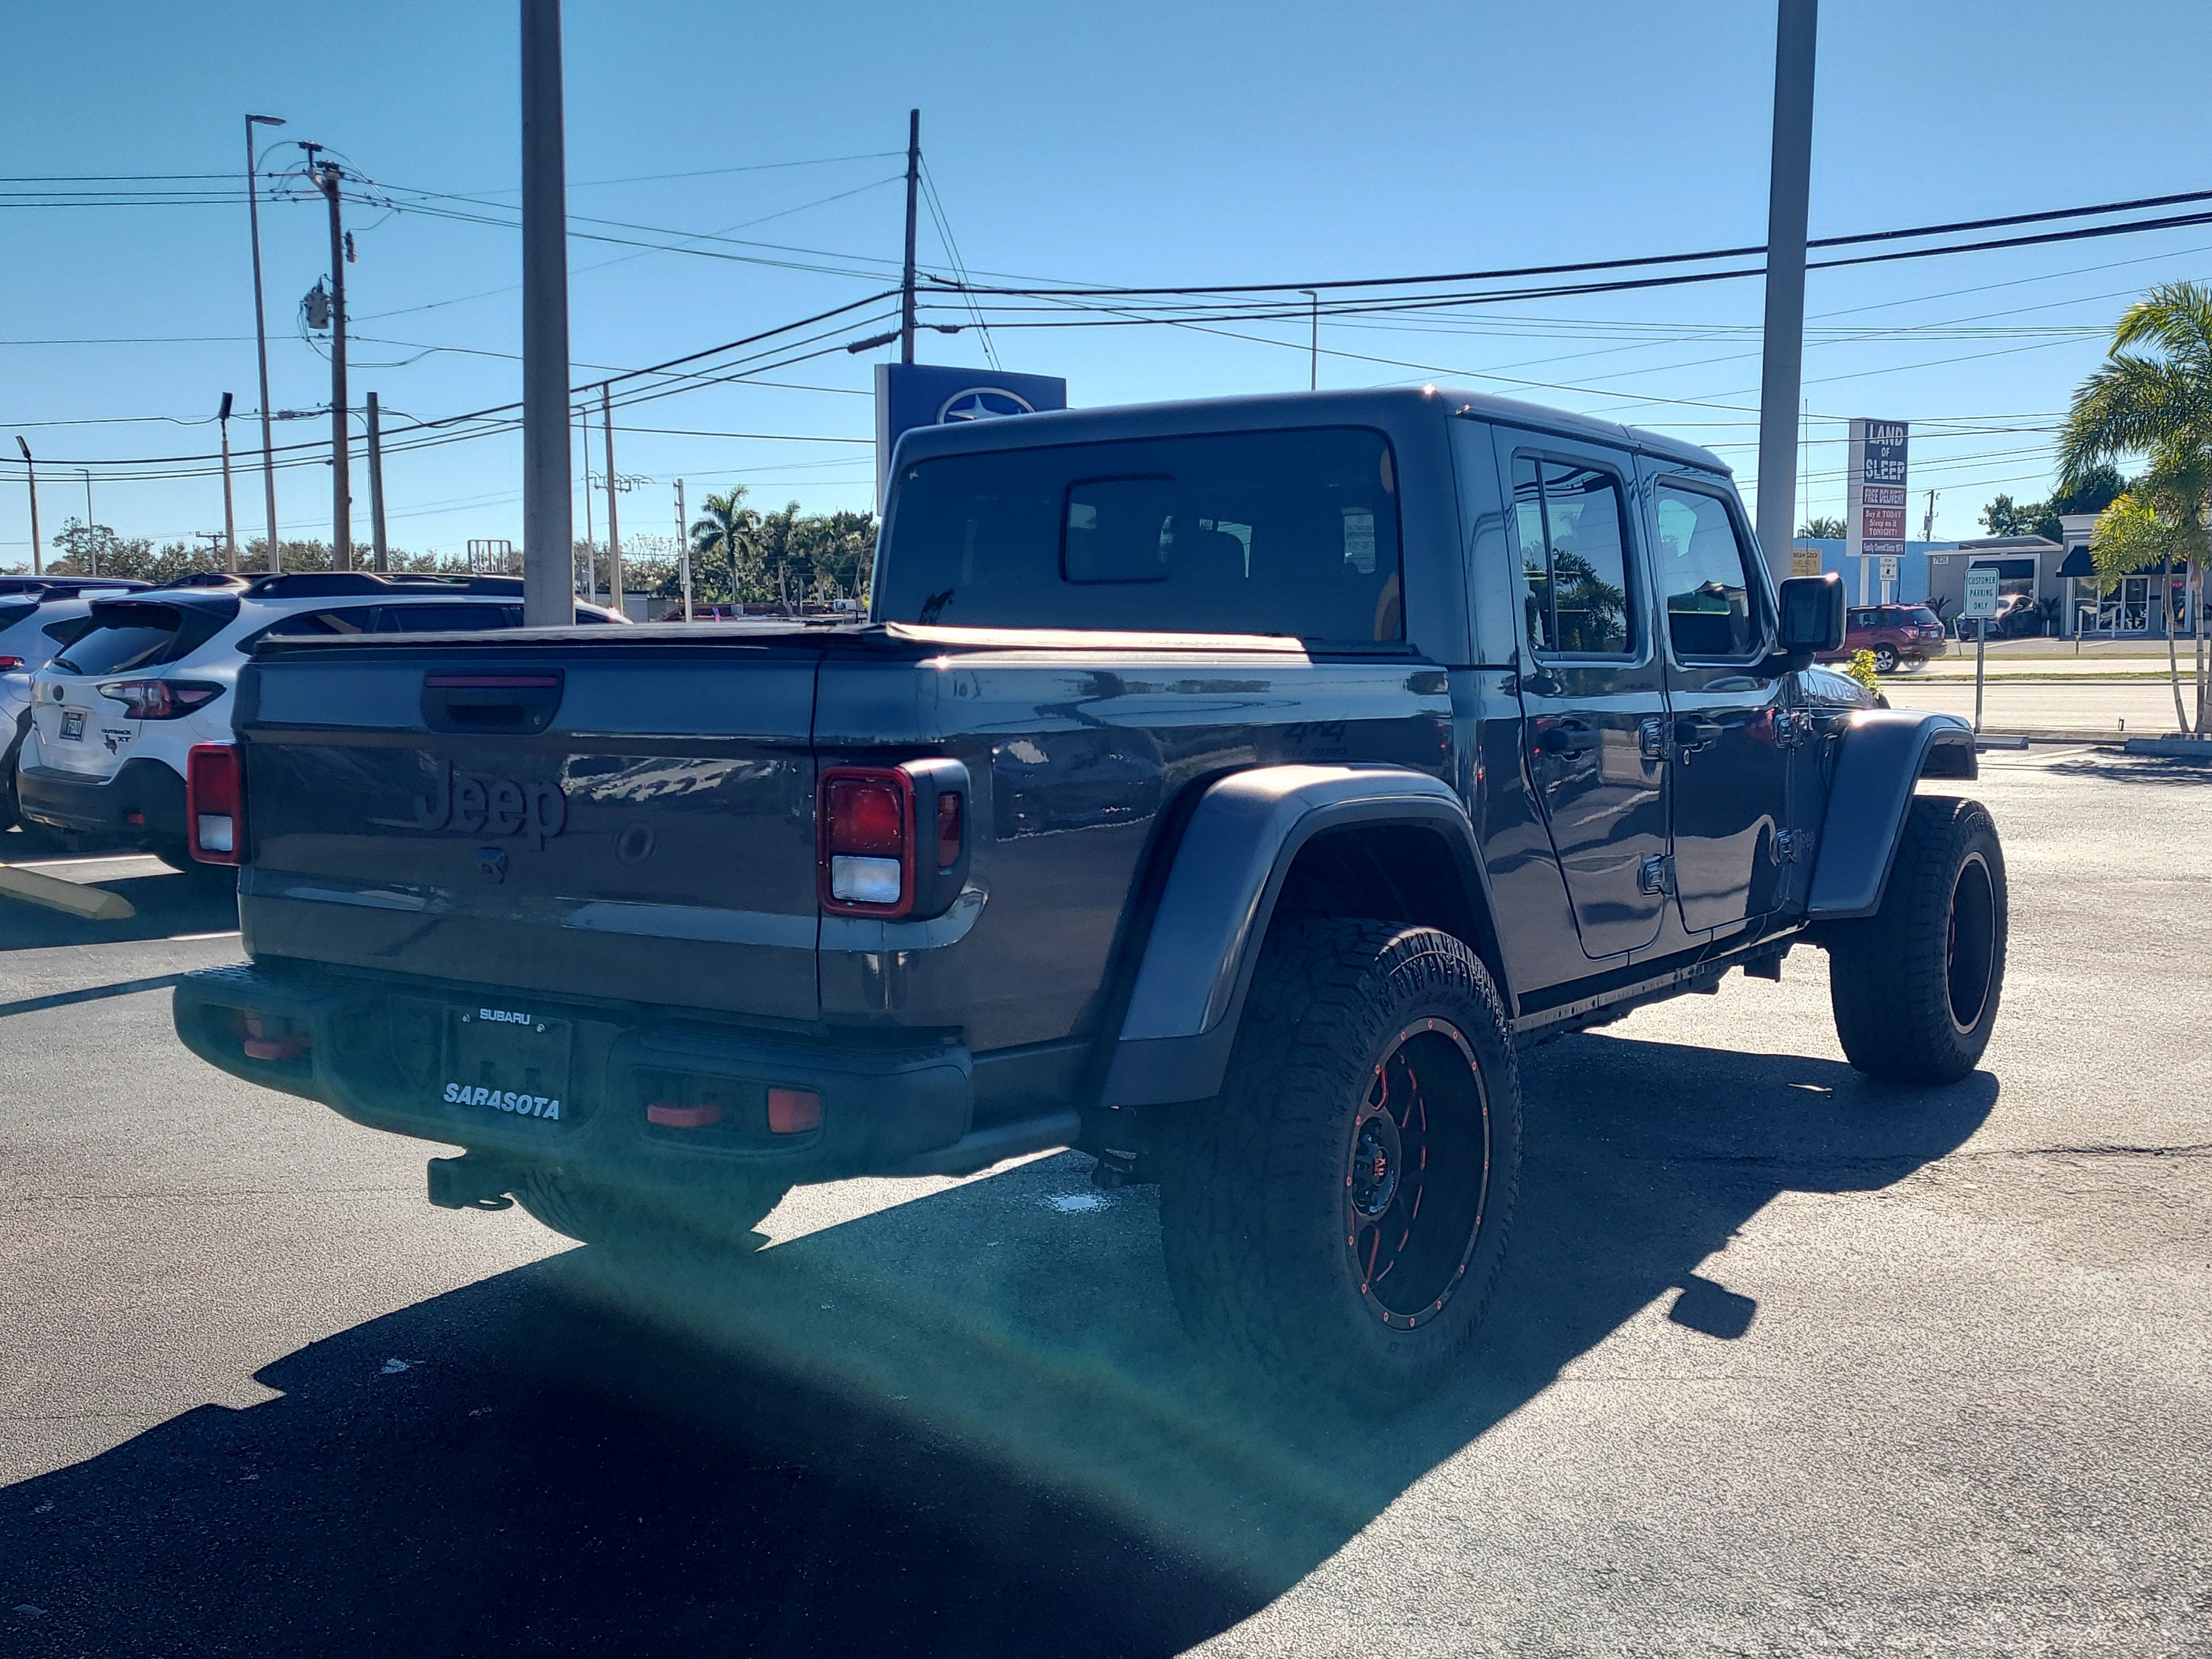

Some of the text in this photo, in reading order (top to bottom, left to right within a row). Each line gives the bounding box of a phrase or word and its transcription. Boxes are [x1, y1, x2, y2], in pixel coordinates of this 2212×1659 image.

[1869, 424, 1904, 446] LAND
[1881, 447, 1890, 457] OF
[1866, 459, 1905, 481] SLEEP
[1865, 488, 1905, 504] FREE DELIVERY
[1866, 510, 1876, 520] Buy
[1869, 519, 1884, 528] Sleep
[1968, 576, 1996, 585] CUSTOMER
[1970, 589, 1994, 597] PARKING
[1973, 602, 1989, 610] ONLY
[414, 758, 568, 851] Jeep
[479, 1008, 531, 1025] SUBARU
[443, 1083, 560, 1120] SARASOTA
